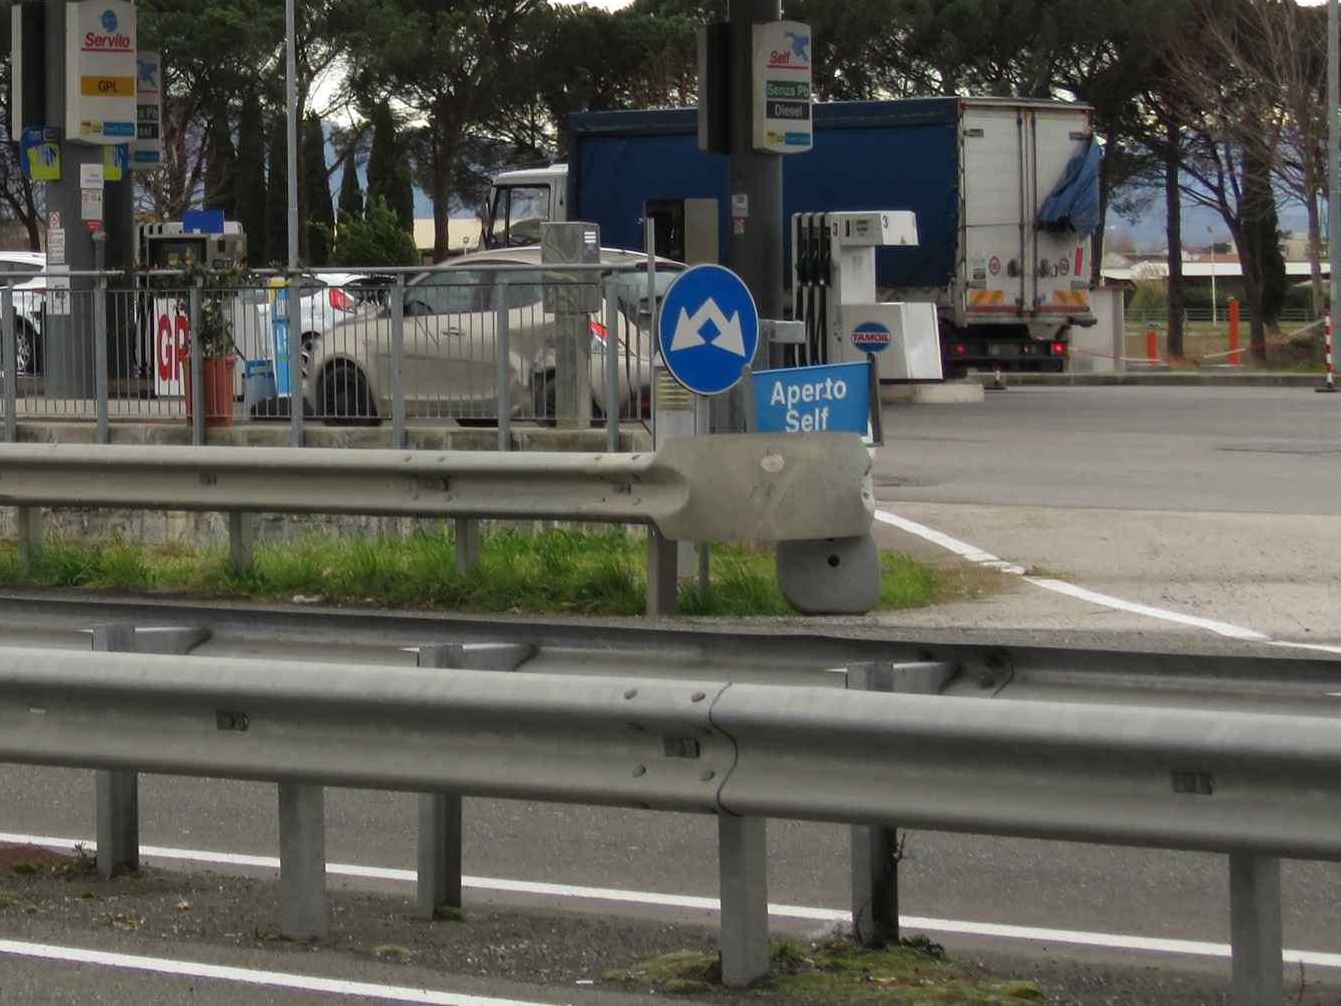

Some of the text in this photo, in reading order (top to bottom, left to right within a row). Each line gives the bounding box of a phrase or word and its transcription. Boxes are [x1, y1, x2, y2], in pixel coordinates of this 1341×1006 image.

[85, 32, 131, 48] Servito
[769, 50, 791, 65] Self
[98, 80, 118, 93] GPL
[774, 103, 803, 117] Diesel
[882, 215, 889, 228] 3
[852, 332, 891, 343] TAMOIL
[770, 377, 847, 410] Aperto
[785, 406, 829, 433] Self
